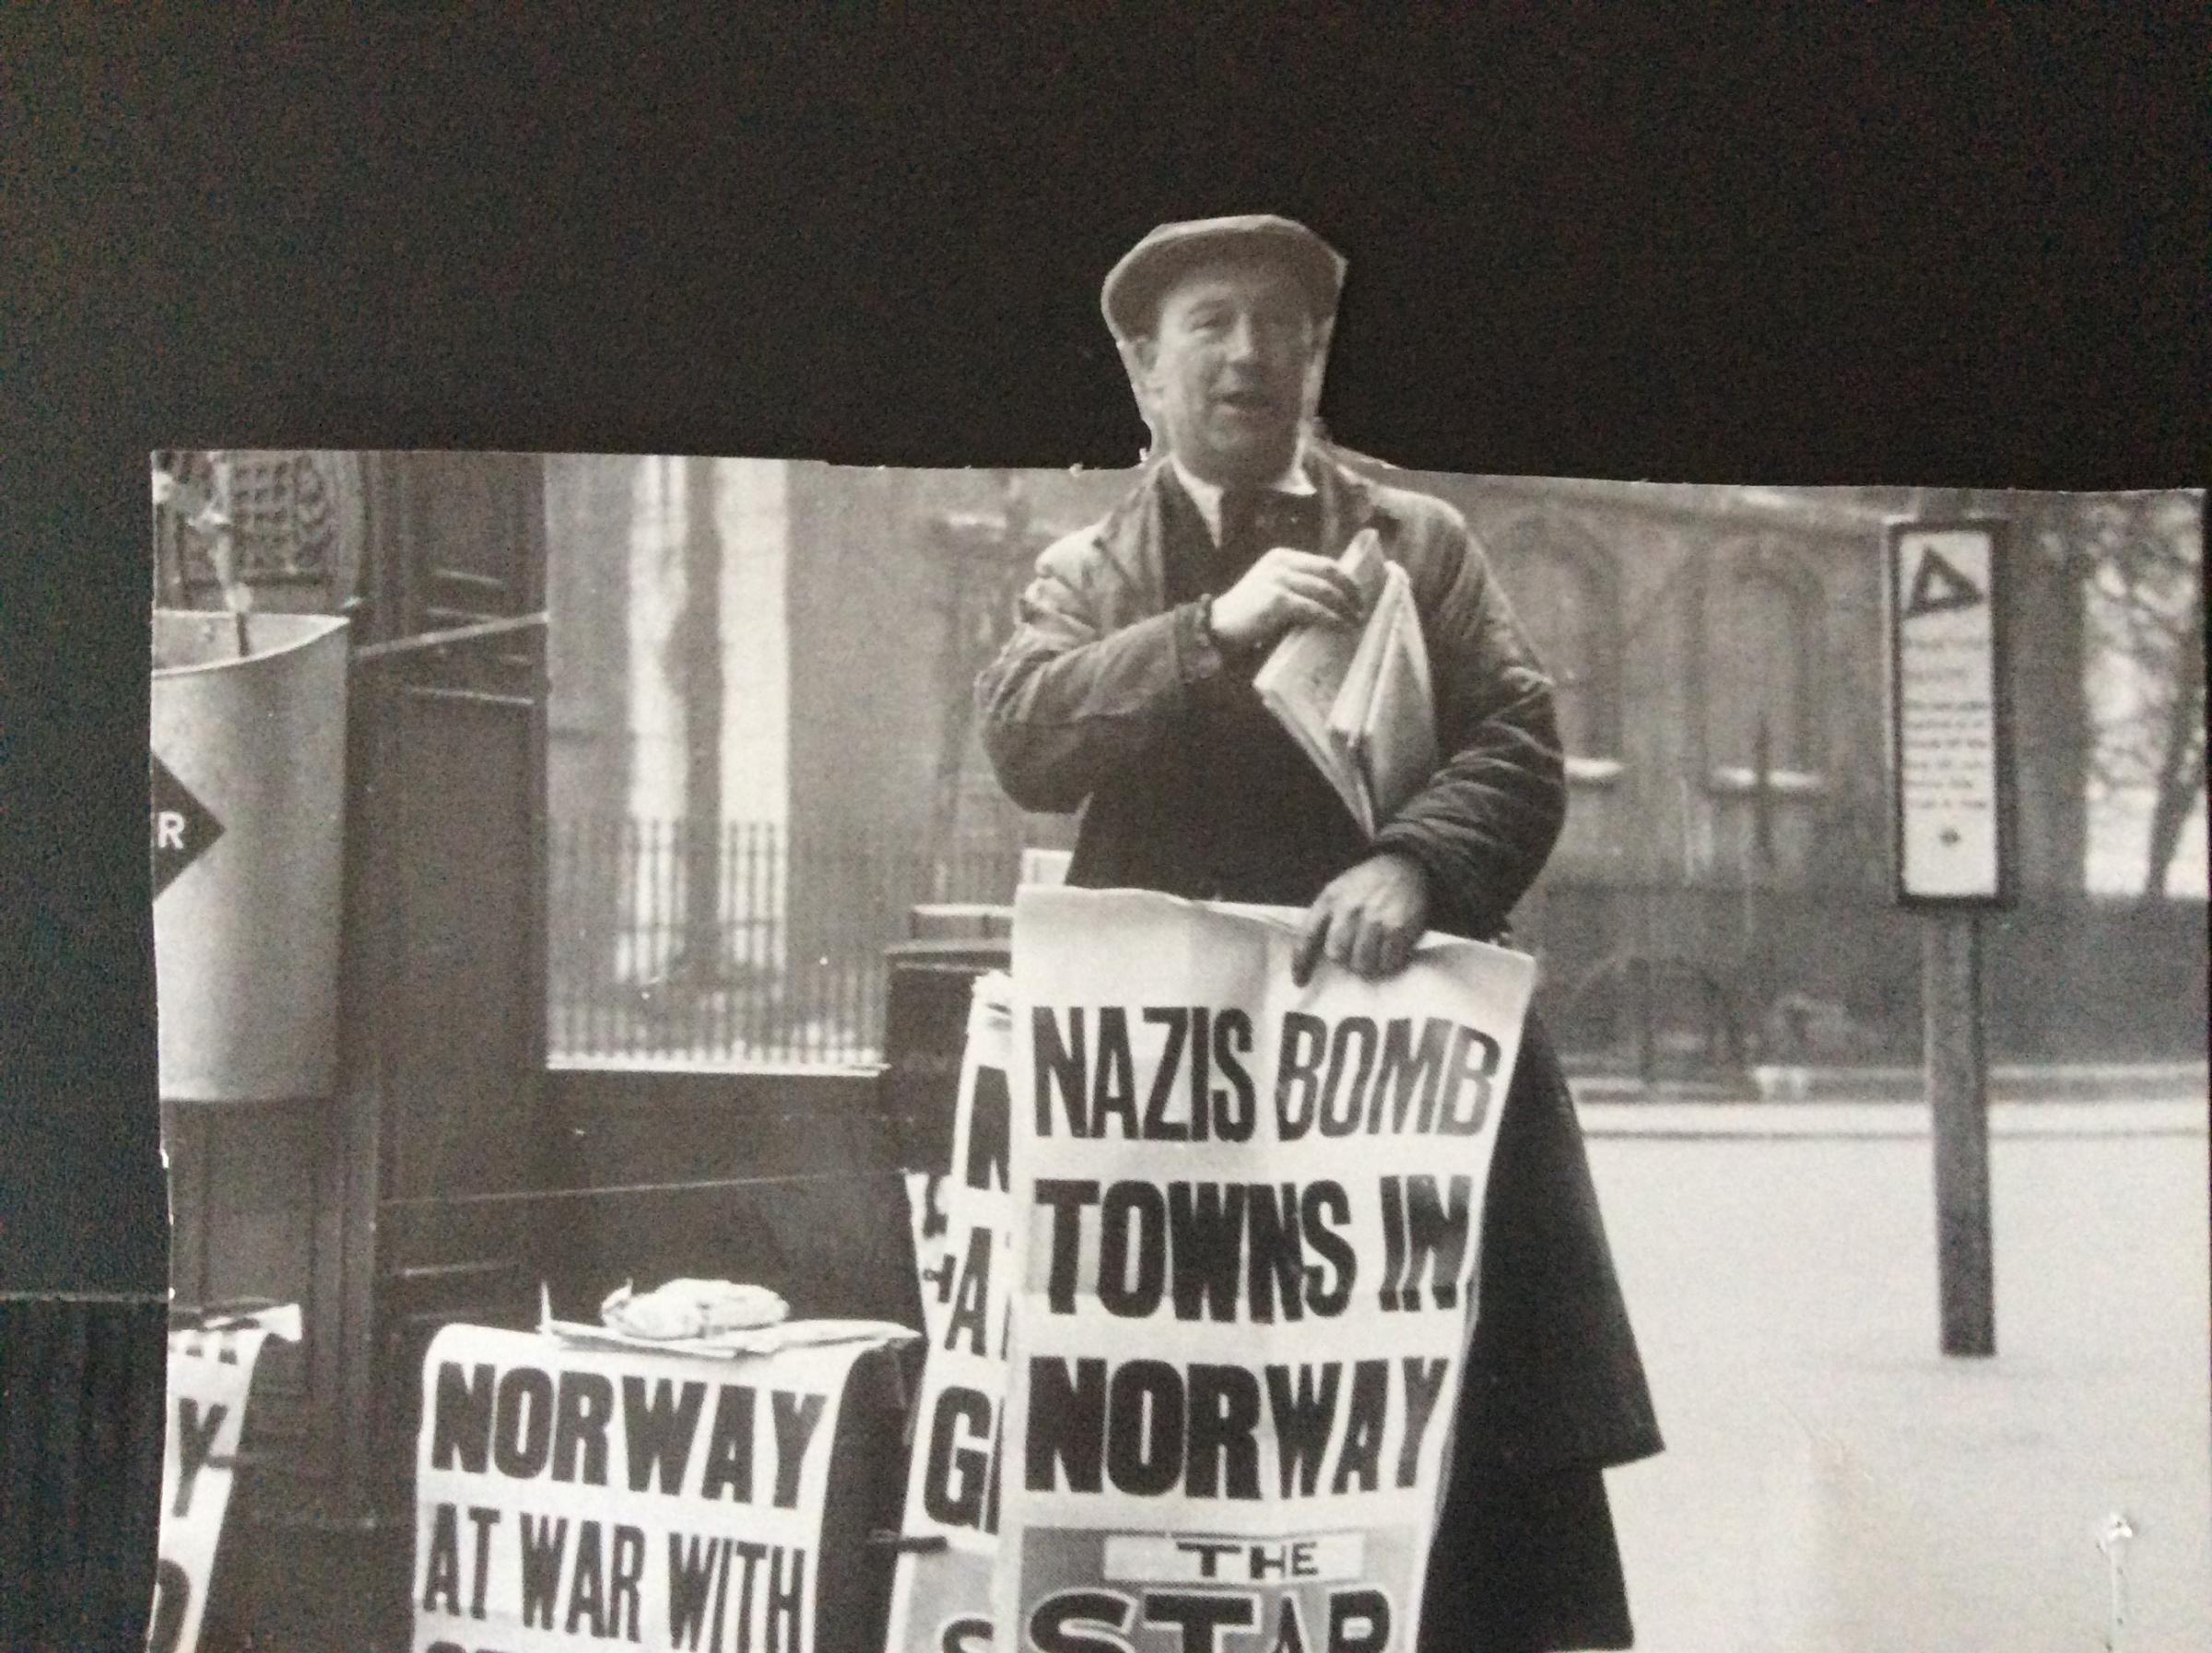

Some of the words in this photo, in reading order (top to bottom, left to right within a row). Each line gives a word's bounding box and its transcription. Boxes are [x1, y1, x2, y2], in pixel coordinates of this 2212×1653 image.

[1031, 1007, 1255, 1142] NAZIS
[1274, 1011, 1502, 1142] BOMB
[1034, 1178, 1358, 1324] TOWNS
[1379, 1175, 1474, 1313] IN
[430, 1361, 829, 1510] NORWAY
[1025, 1356, 1450, 1501] NORWAY
[423, 1504, 500, 1620] AT
[520, 1511, 649, 1646] WAR
[667, 1532, 806, 1653] WITH
[1176, 1541, 1319, 1580] THE
